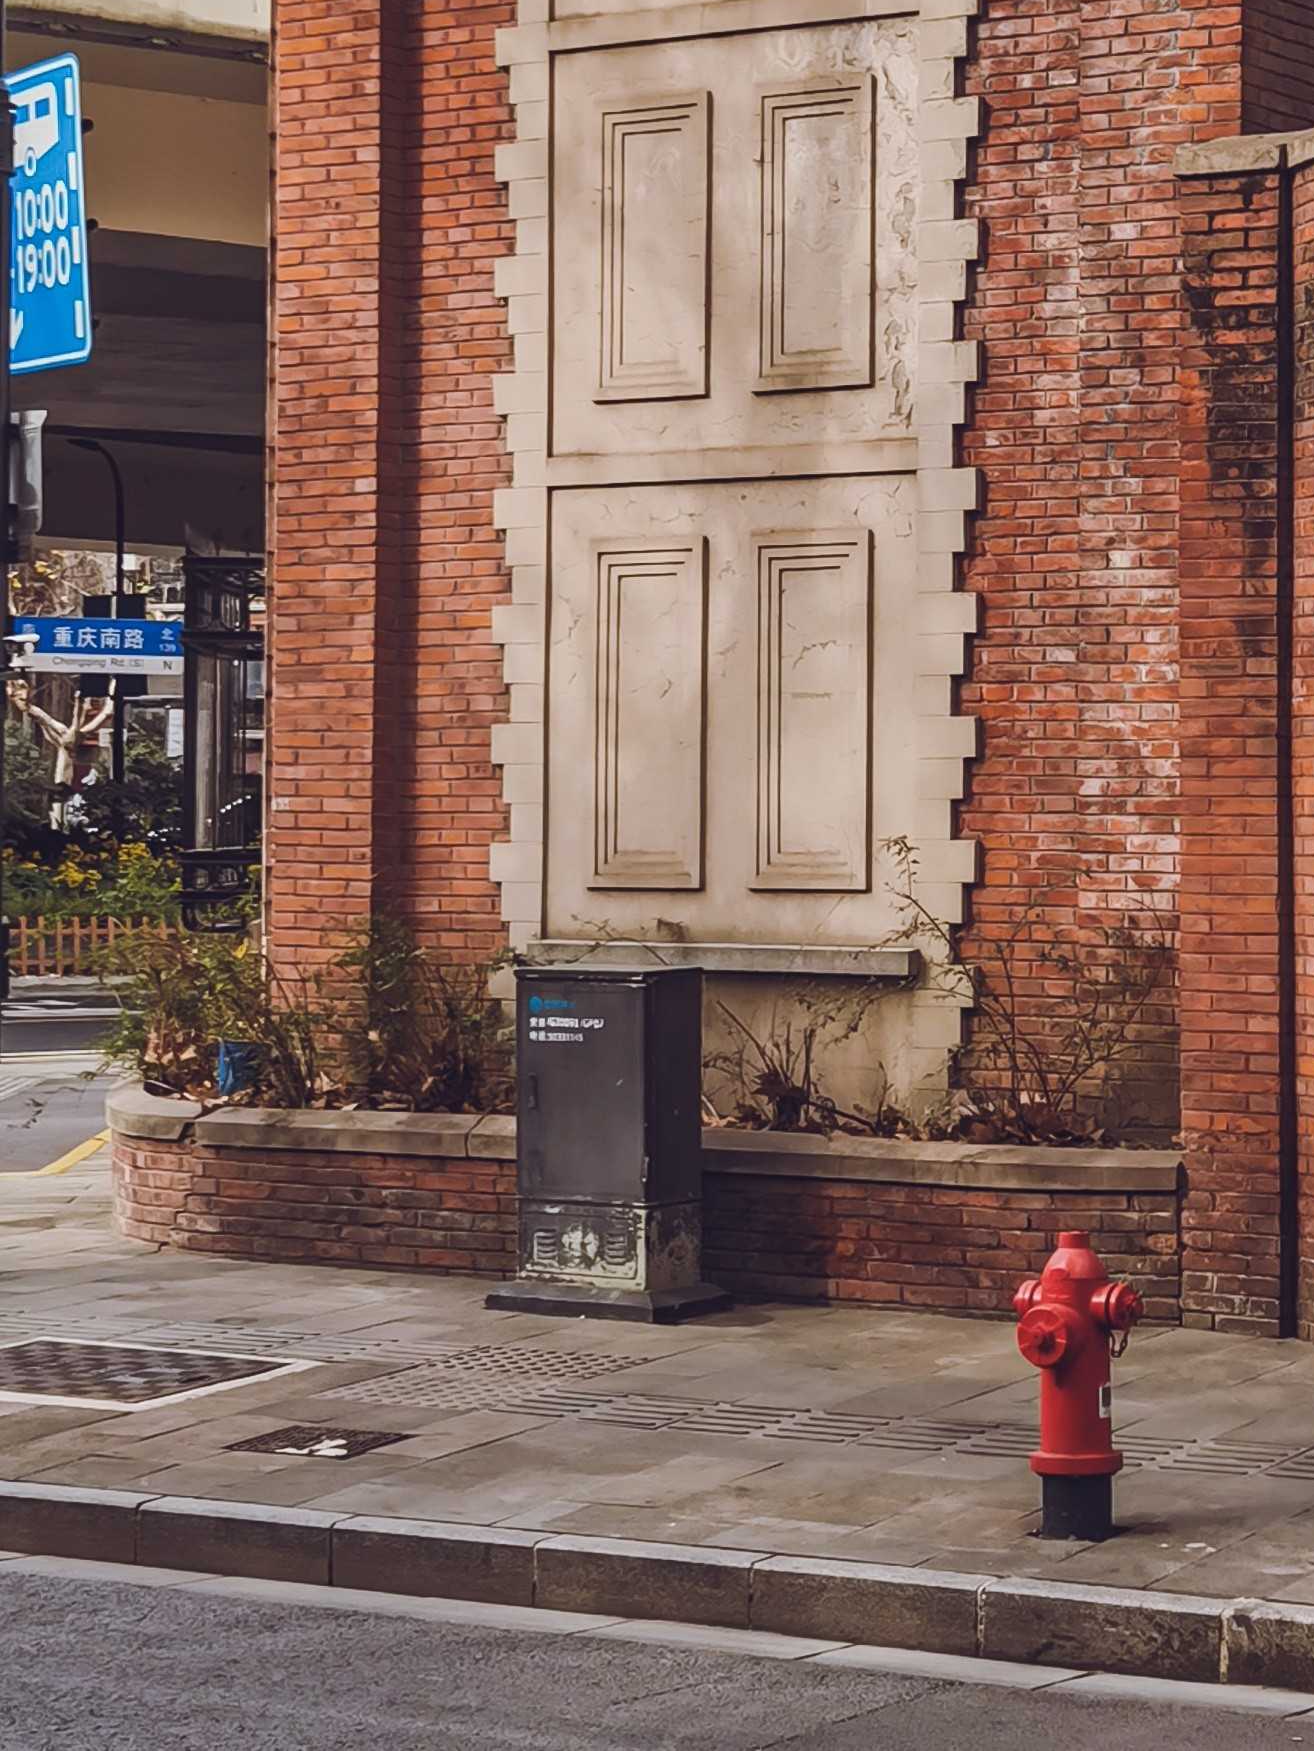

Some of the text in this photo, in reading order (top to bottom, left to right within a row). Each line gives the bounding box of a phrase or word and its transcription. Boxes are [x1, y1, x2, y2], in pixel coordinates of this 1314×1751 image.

[16, 180, 69, 240] 10:00
[16, 235, 71, 294] 19:00
[52, 626, 145, 650] 重庆南路
[163, 660, 173, 671] N
